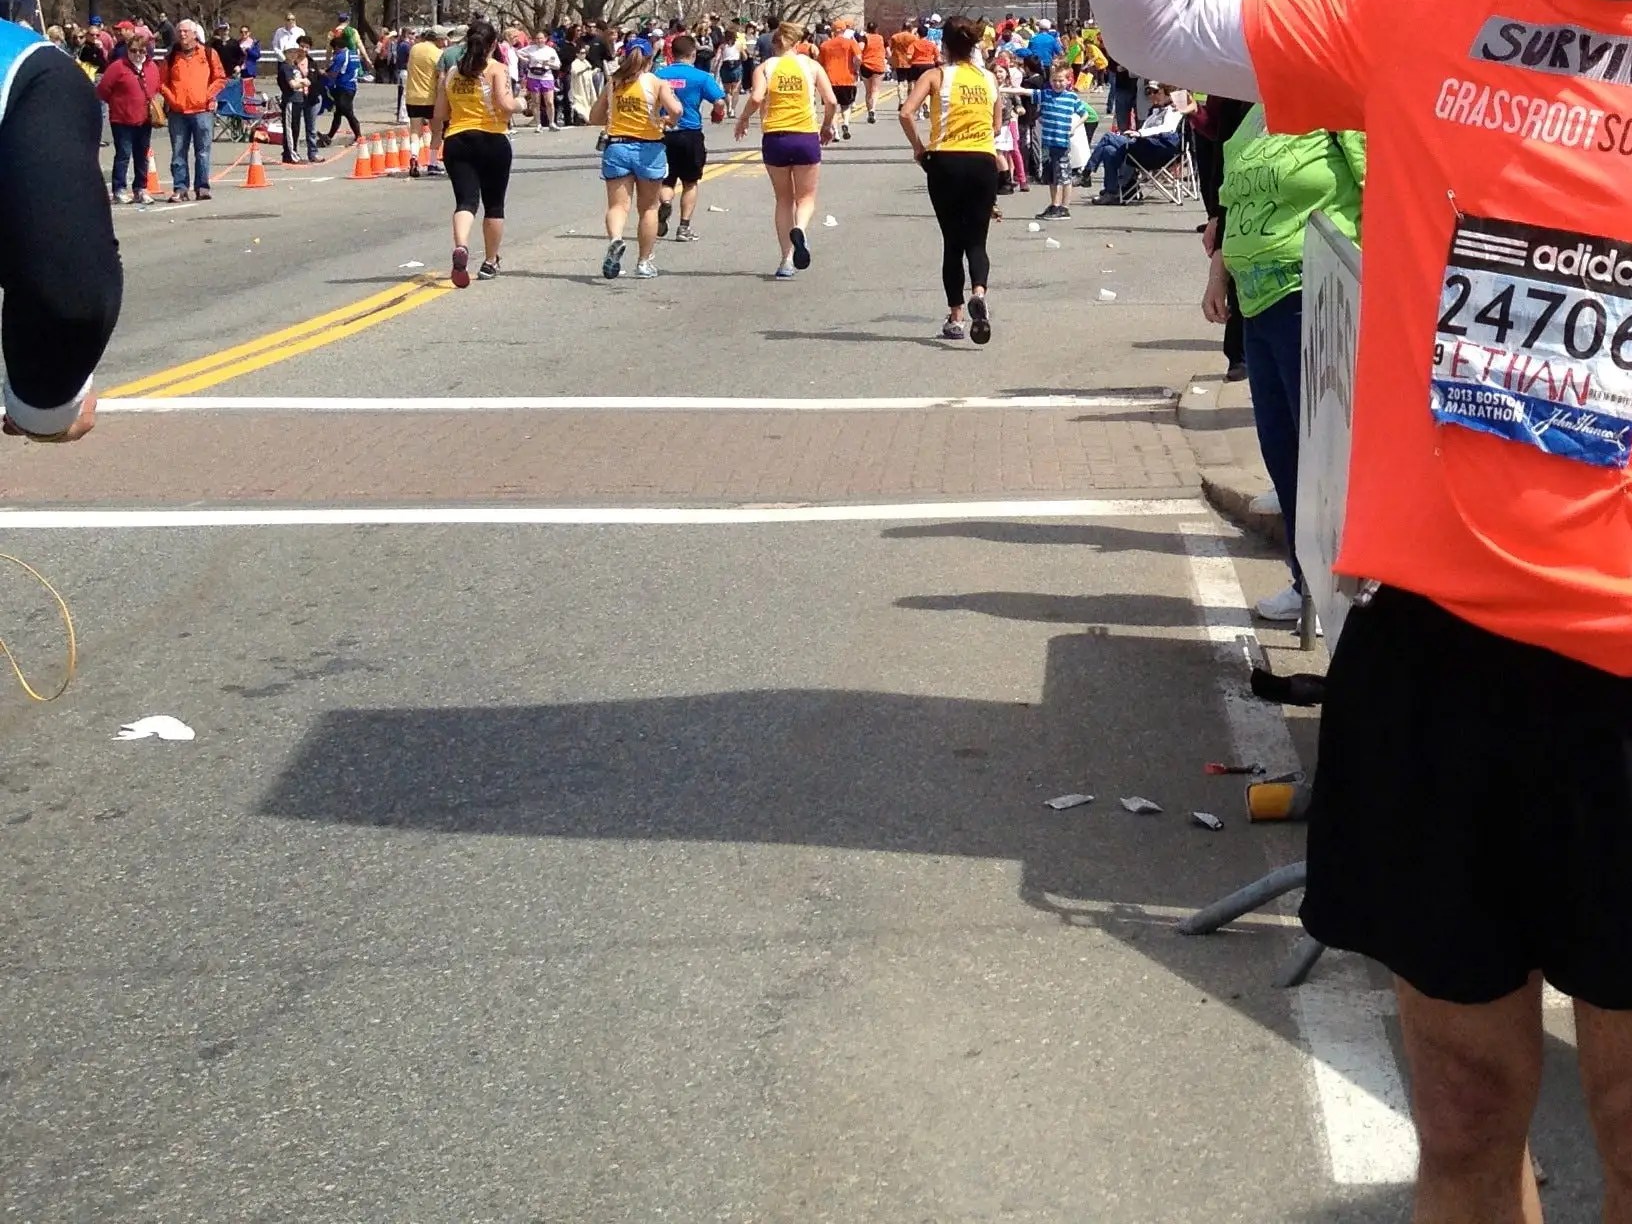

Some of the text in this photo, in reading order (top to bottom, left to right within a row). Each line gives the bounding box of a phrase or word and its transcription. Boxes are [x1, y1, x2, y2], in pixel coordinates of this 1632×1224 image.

[1225, 200, 1279, 238] 26.2
[1450, 340, 1592, 407] ETHAN
[1444, 401, 1525, 424] MARATHON
[1447, 387, 1526, 412] 2013 BOSTON
